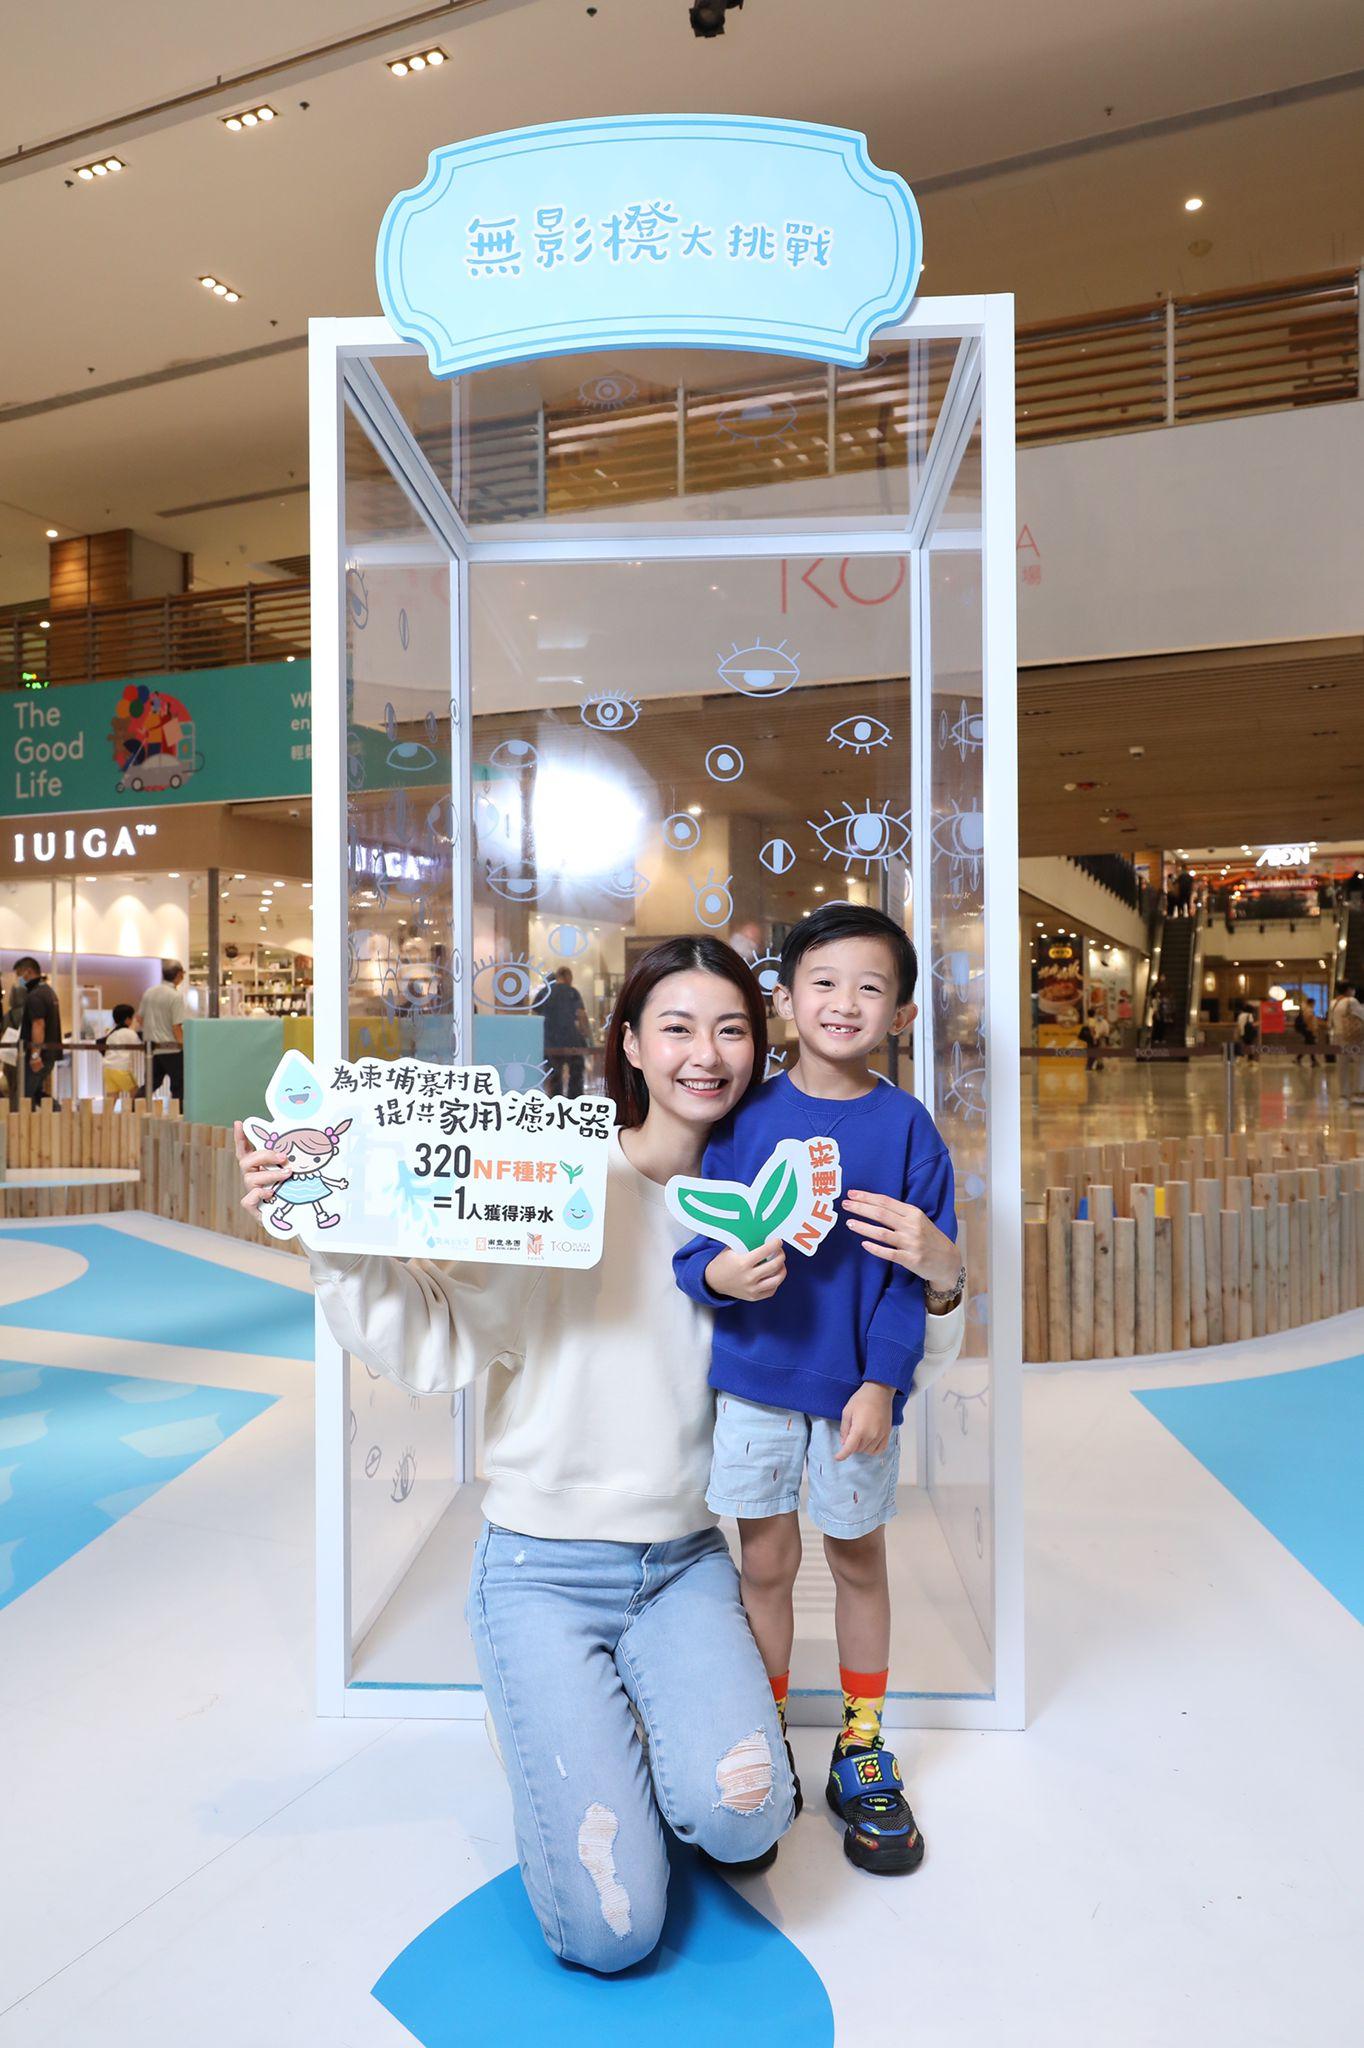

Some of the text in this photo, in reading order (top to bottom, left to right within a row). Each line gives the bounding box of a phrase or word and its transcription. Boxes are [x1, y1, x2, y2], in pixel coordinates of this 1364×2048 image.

[14, 702, 61, 730] The
[14, 731, 84, 764] Good
[15, 770, 63, 799] Life
[375, 1097, 611, 1140] 提供家用濾水器
